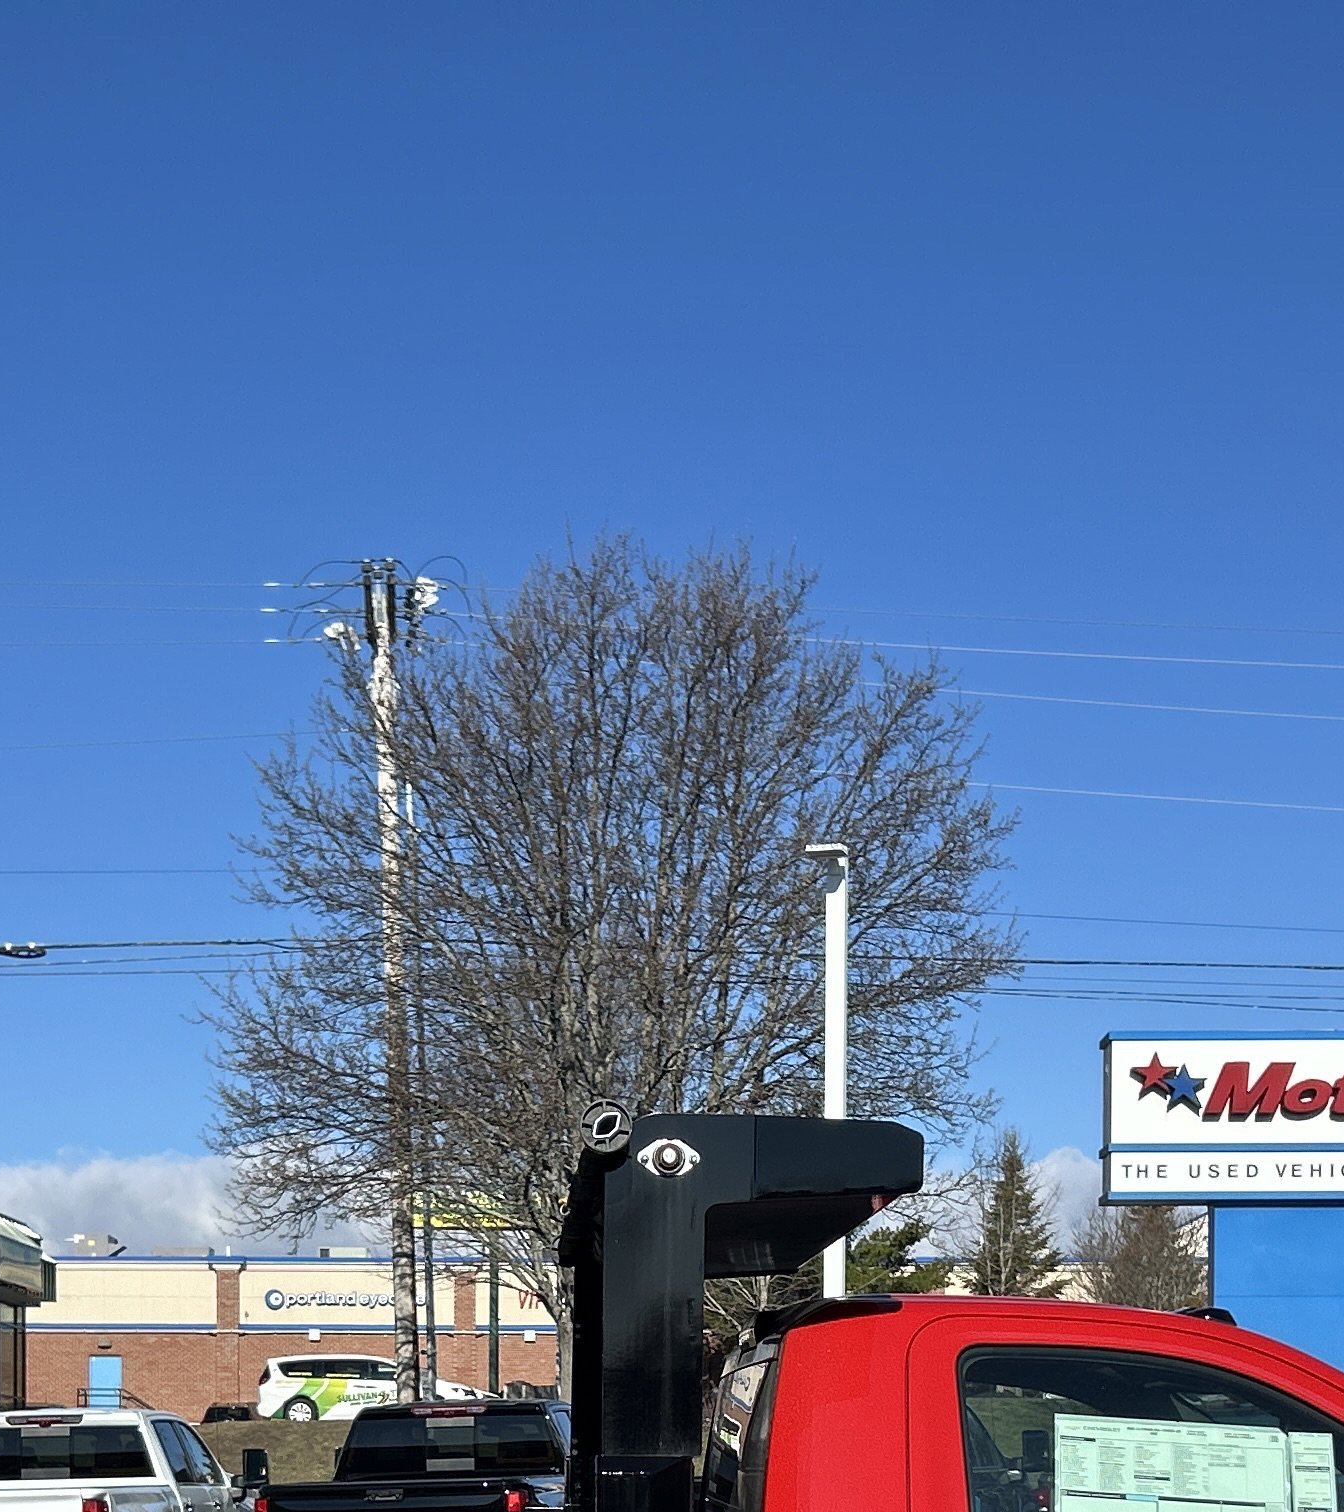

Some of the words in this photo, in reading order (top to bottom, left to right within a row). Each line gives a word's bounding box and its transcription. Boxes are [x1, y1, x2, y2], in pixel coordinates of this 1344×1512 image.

[1122, 1164, 1168, 1179] THE
[1189, 1164, 1259, 1179] USED
[285, 1290, 357, 1308] portland
[336, 1391, 378, 1404] SULLIVAN
